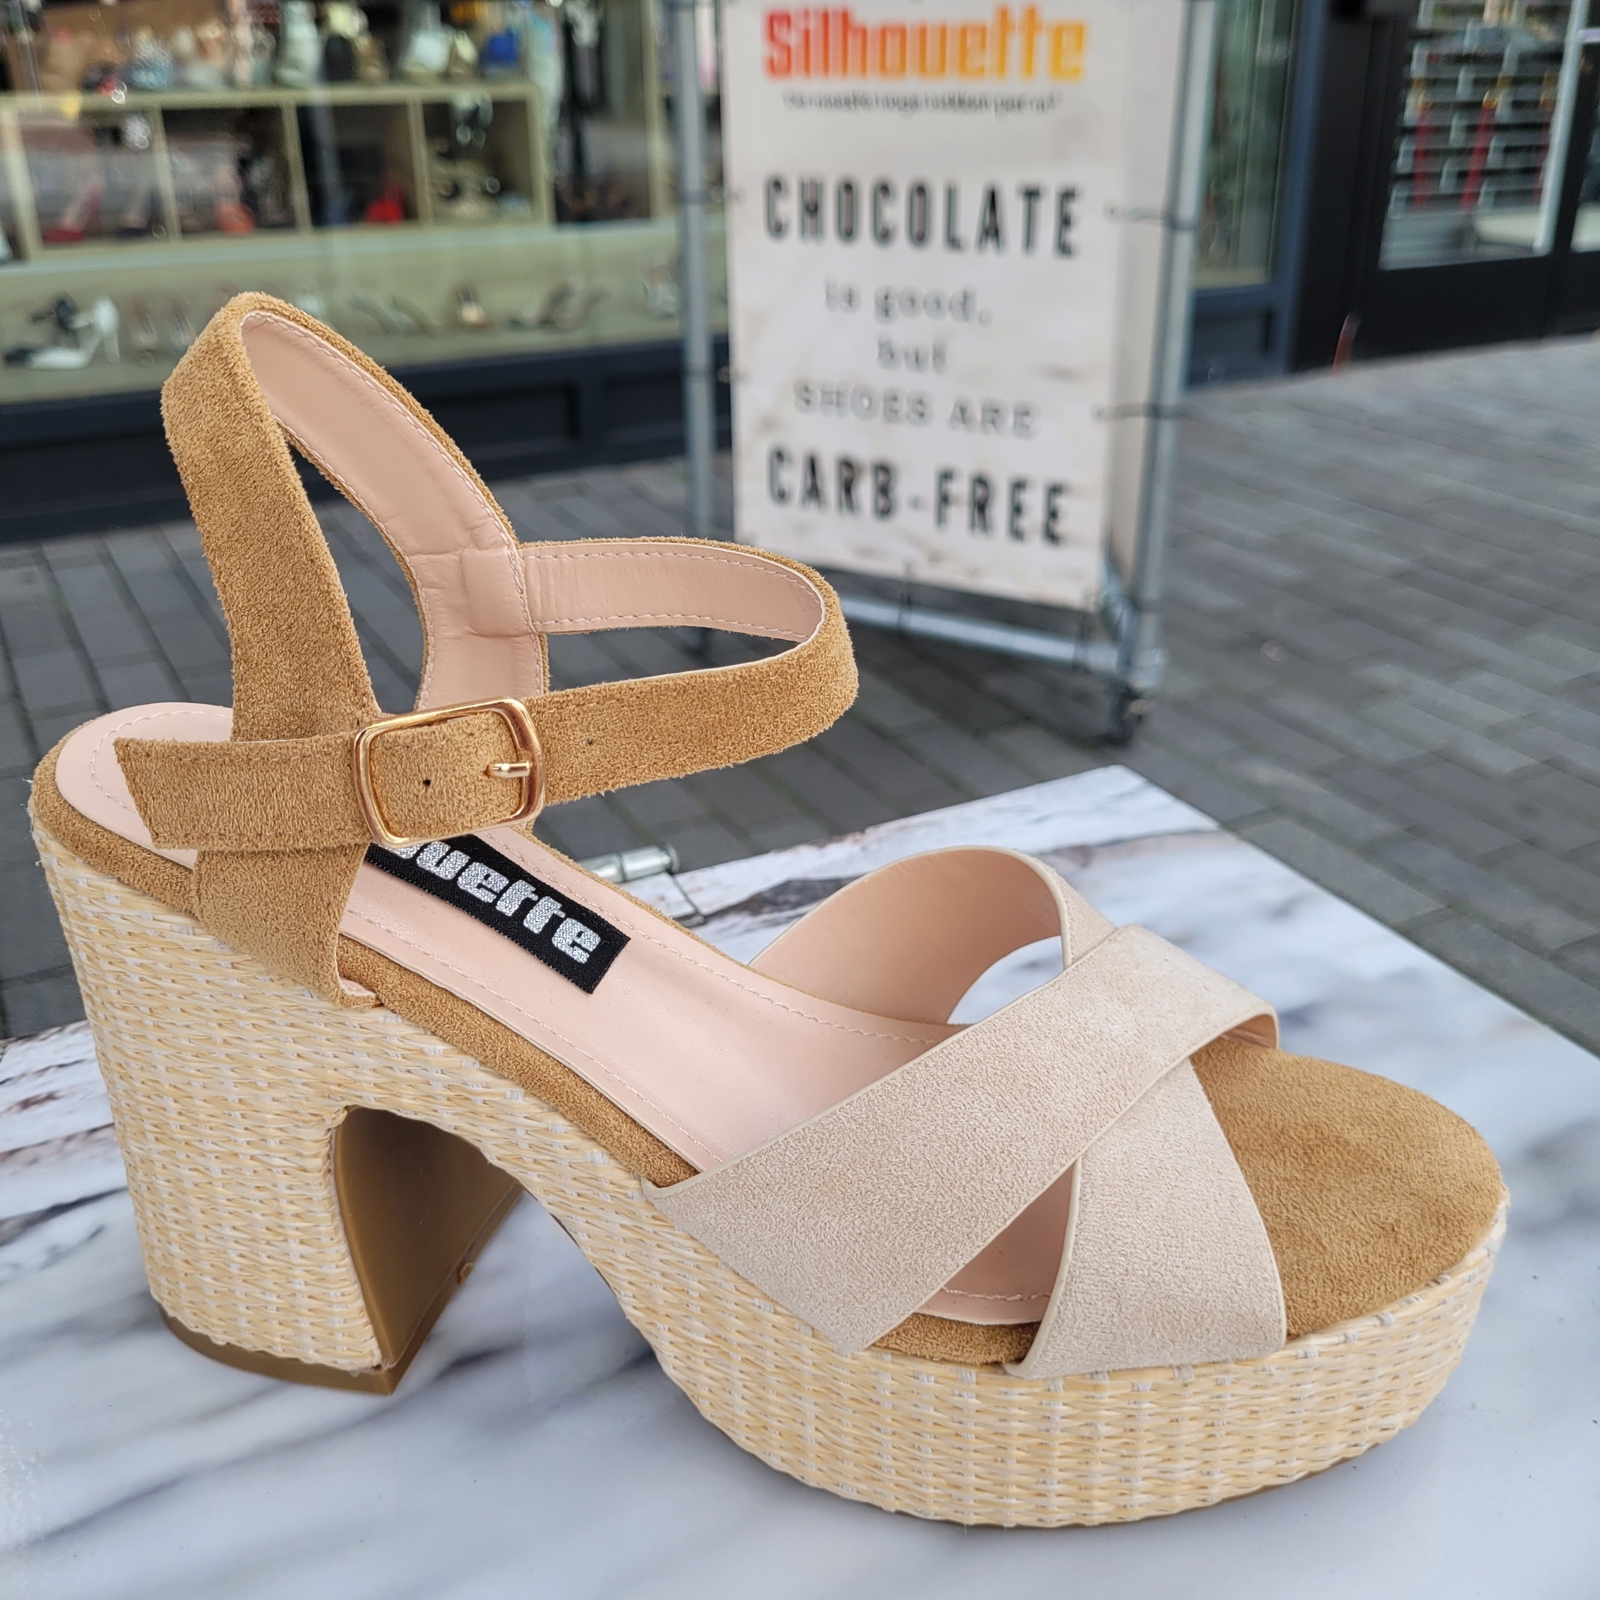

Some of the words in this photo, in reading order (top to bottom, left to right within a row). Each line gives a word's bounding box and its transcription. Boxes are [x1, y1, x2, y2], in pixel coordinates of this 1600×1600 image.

[765, 7, 1087, 81] Silhouette
[766, 178, 1079, 258] CHOCOLATE
[878, 336, 946, 374] but
[795, 379, 931, 426] SHOES
[950, 398, 1038, 438] ARE
